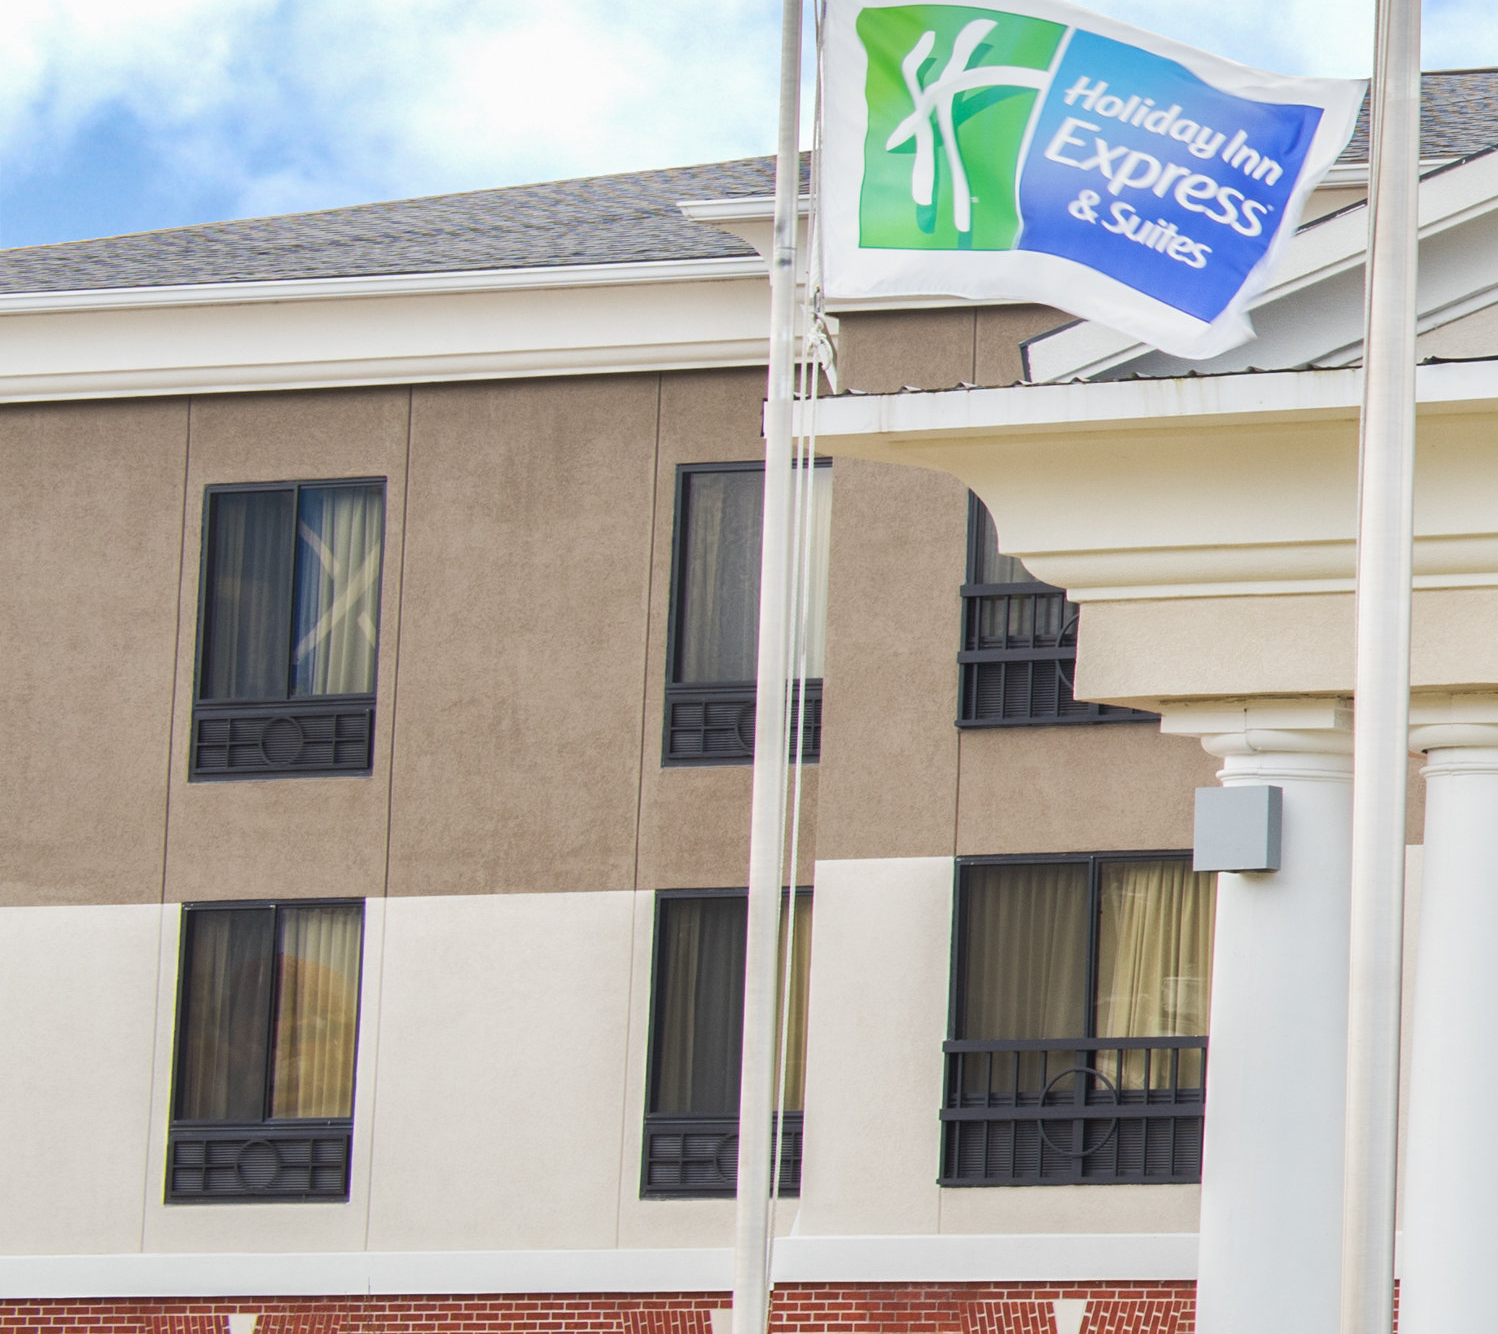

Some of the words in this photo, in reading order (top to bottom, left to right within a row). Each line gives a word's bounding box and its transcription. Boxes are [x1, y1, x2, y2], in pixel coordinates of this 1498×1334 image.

[1044, 116, 1268, 237] Express
[1063, 75, 1227, 159] Holiday
[1221, 129, 1283, 186] Inn
[1067, 189, 1100, 224] &
[1101, 201, 1213, 269] Suites
